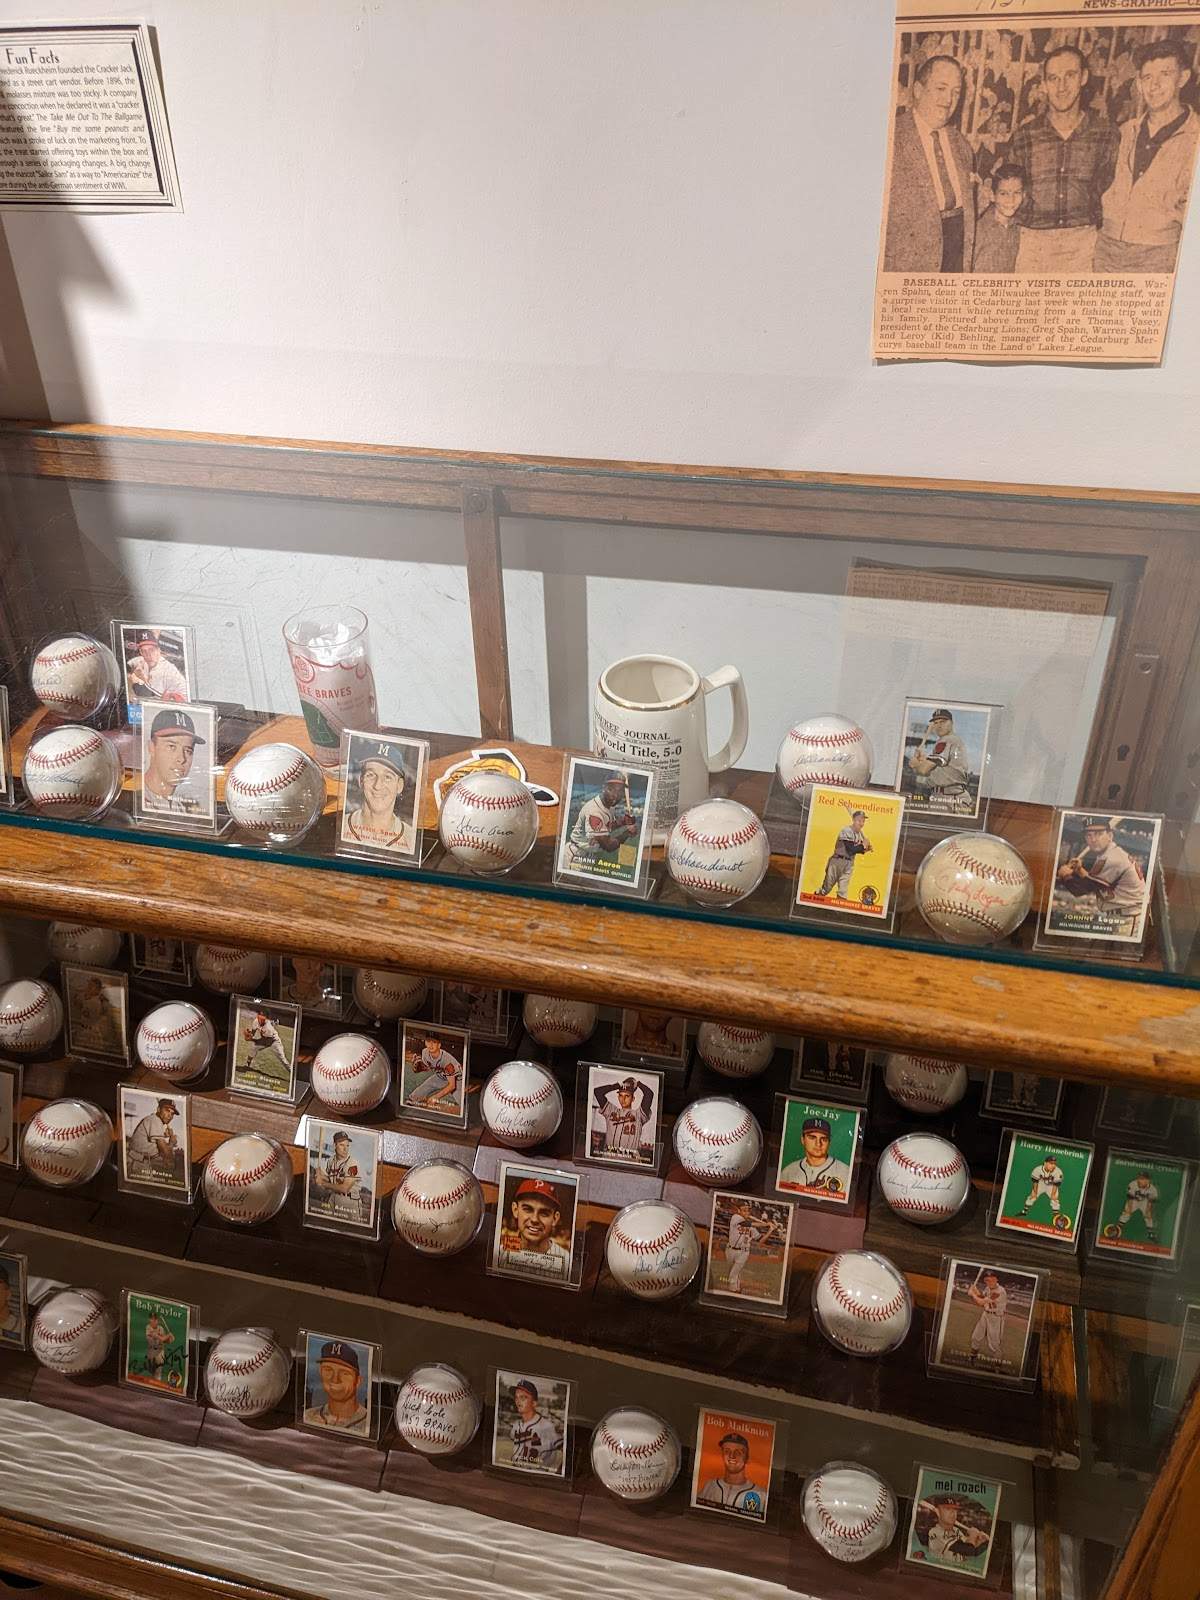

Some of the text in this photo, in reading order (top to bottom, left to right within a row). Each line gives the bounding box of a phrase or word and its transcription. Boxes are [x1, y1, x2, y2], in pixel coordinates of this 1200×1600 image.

[6, 47, 60, 64] Fun Facts
[903, 278, 1168, 288] BASEBALL CELEBRITY VISITS CEDARBURG. War-
[901, 288, 931, 297] Spahn,
[935, 288, 956, 296] dean
[960, 288, 970, 297] of
[972, 289, 987, 297] the
[990, 289, 1040, 298] Milwaukee
[1044, 289, 1075, 297] Braves
[1078, 289, 1117, 299] pitching
[1121, 290, 1144, 298] staff,
[890, 298, 927, 306] surprise
[961, 298, 970, 306] in
[974, 298, 1022, 307] Cedarburg
[1072, 299, 1096, 307] when
[1101, 299, 1112, 307] he
[1115, 300, 1151, 308] stopped
[967, 307, 992, 315] while
[996, 308, 1039, 317] returning
[1081, 308, 1114, 317] fishing
[1118, 308, 1136, 318] trip
[1141, 309, 1162, 317] with
[881, 314, 894, 322] his
[900, 315, 930, 324] family.
[939, 315, 977, 324] Pictured
[983, 316, 1009, 324] above
[1044, 317, 1060, 325] left
[1087, 317, 1124, 326] Thomas
[1131, 318, 1161, 327] Vasey,
[880, 323, 921, 333] president
[935, 324, 948, 332] the
[951, 324, 999, 334] Cedarburg
[1001, 326, 1029, 334] Lions;
[1032, 326, 1055, 334] Greg
[1057, 326, 1088, 335] Spahn,
[1092, 327, 1127, 335] Warren
[1129, 327, 1159, 336] Spahn
[879, 332, 1158, 345] and Leroy (Kid) Behling, manager of the Cedarburg Mer-
[906, 341, 941, 349] baseball
[944, 342, 966, 350] team
[970, 342, 979, 350] in
[982, 343, 996, 351] the
[1000, 343, 1023, 351] Land
[1038, 344, 1065, 352] Lakes
[1069, 345, 1105, 353] League.
[315, 686, 352, 699] BRAVES
[624, 730, 671, 741] JOURNAL
[600, 730, 682, 759] World Title, 5-0
[818, 795, 894, 815] Red Schoendienst
[598, 859, 621, 870] Aaron
[1064, 913, 1126, 925] JOHNNY Logan
[822, 1109, 841, 1121] Jay
[1020, 1140, 1085, 1160] Harry Hanebrink
[136, 1300, 183, 1318] Bob Taylor
[706, 1416, 770, 1437] Bob Malkmus
[935, 1479, 987, 1495] mel roach
